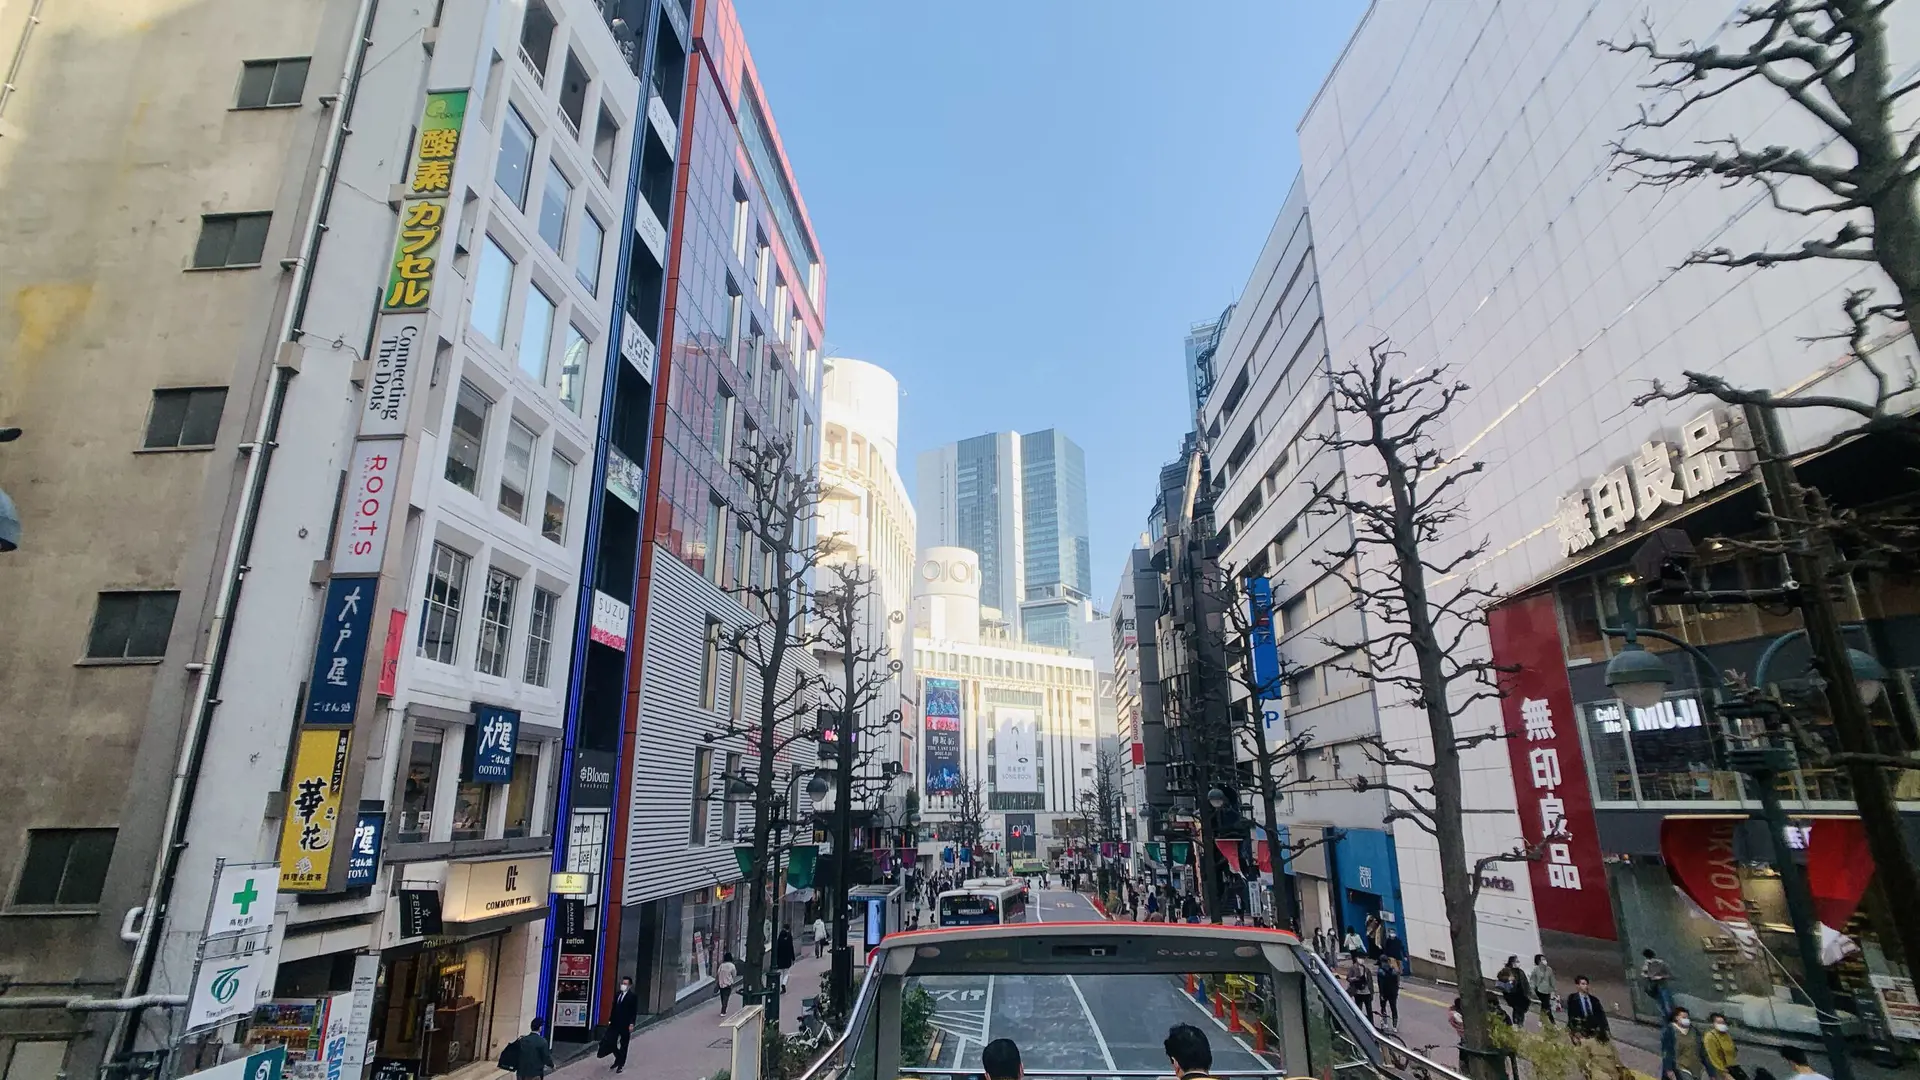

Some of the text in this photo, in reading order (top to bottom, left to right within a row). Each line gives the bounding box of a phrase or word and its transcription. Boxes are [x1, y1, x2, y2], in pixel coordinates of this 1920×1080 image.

[369, 336, 399, 411] The Dots
[380, 325, 418, 420] Connecting
[1556, 408, 1742, 558] 無印良品
[354, 454, 388, 556] ROOTS
[598, 597, 625, 621] SUZU
[325, 586, 361, 686] 大戸屋
[313, 702, 351, 713] ごはん処
[1265, 711, 1279, 729] P
[1634, 698, 1702, 731] MUJI
[479, 715, 512, 755] 大戸屋
[1604, 719, 1631, 734] Mel
[478, 765, 507, 776] OOTOYA
[586, 766, 609, 783] Bloom
[1522, 697, 1582, 890] 無印良品
[411, 893, 423, 935] ZENITH
[485, 895, 532, 911] COMMON TIME
